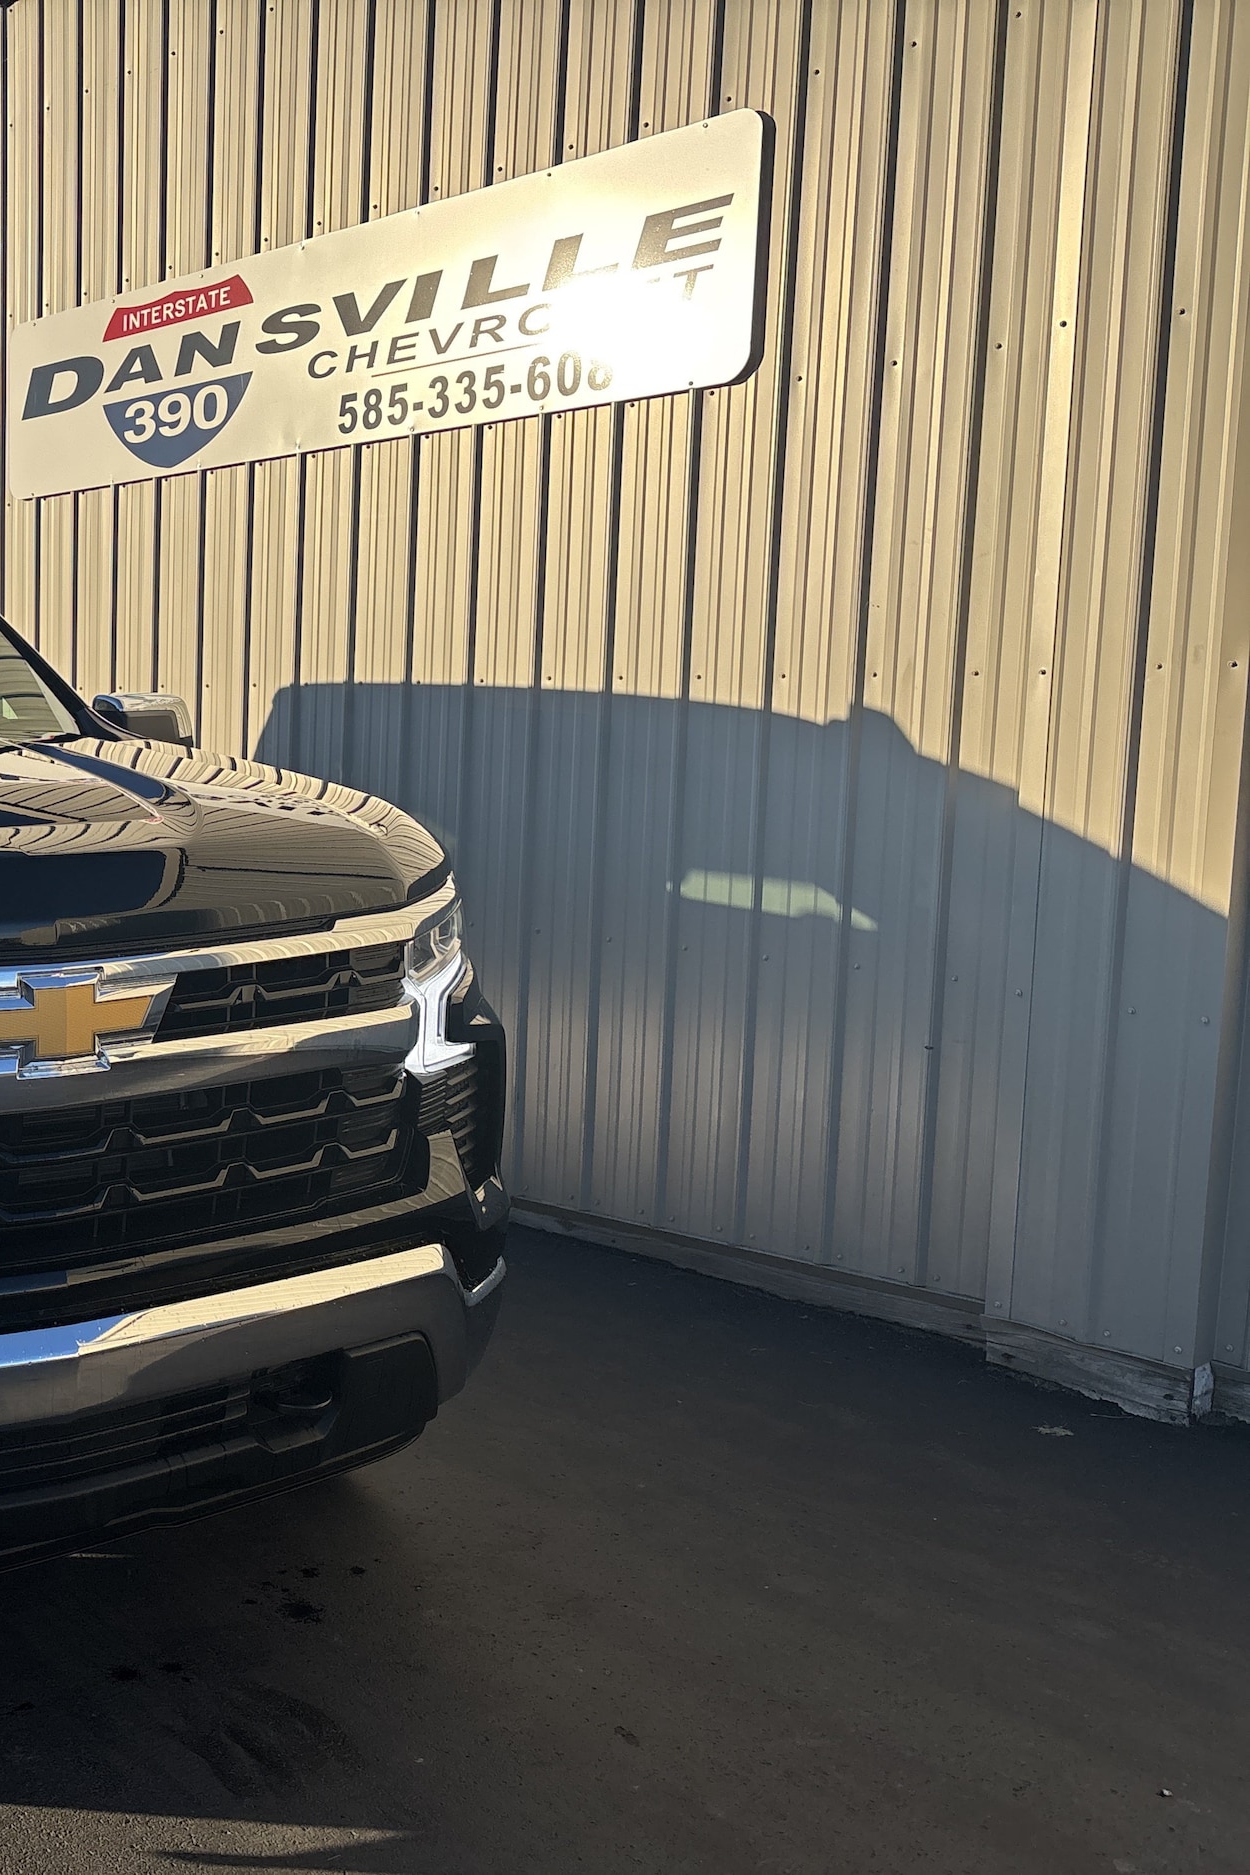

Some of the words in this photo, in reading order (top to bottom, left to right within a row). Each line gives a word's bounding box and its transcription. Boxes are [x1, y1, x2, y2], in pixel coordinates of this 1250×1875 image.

[21, 193, 735, 421] DANSVILLE
[122, 286, 231, 332] INTERSTATE
[123, 384, 229, 444] 390
